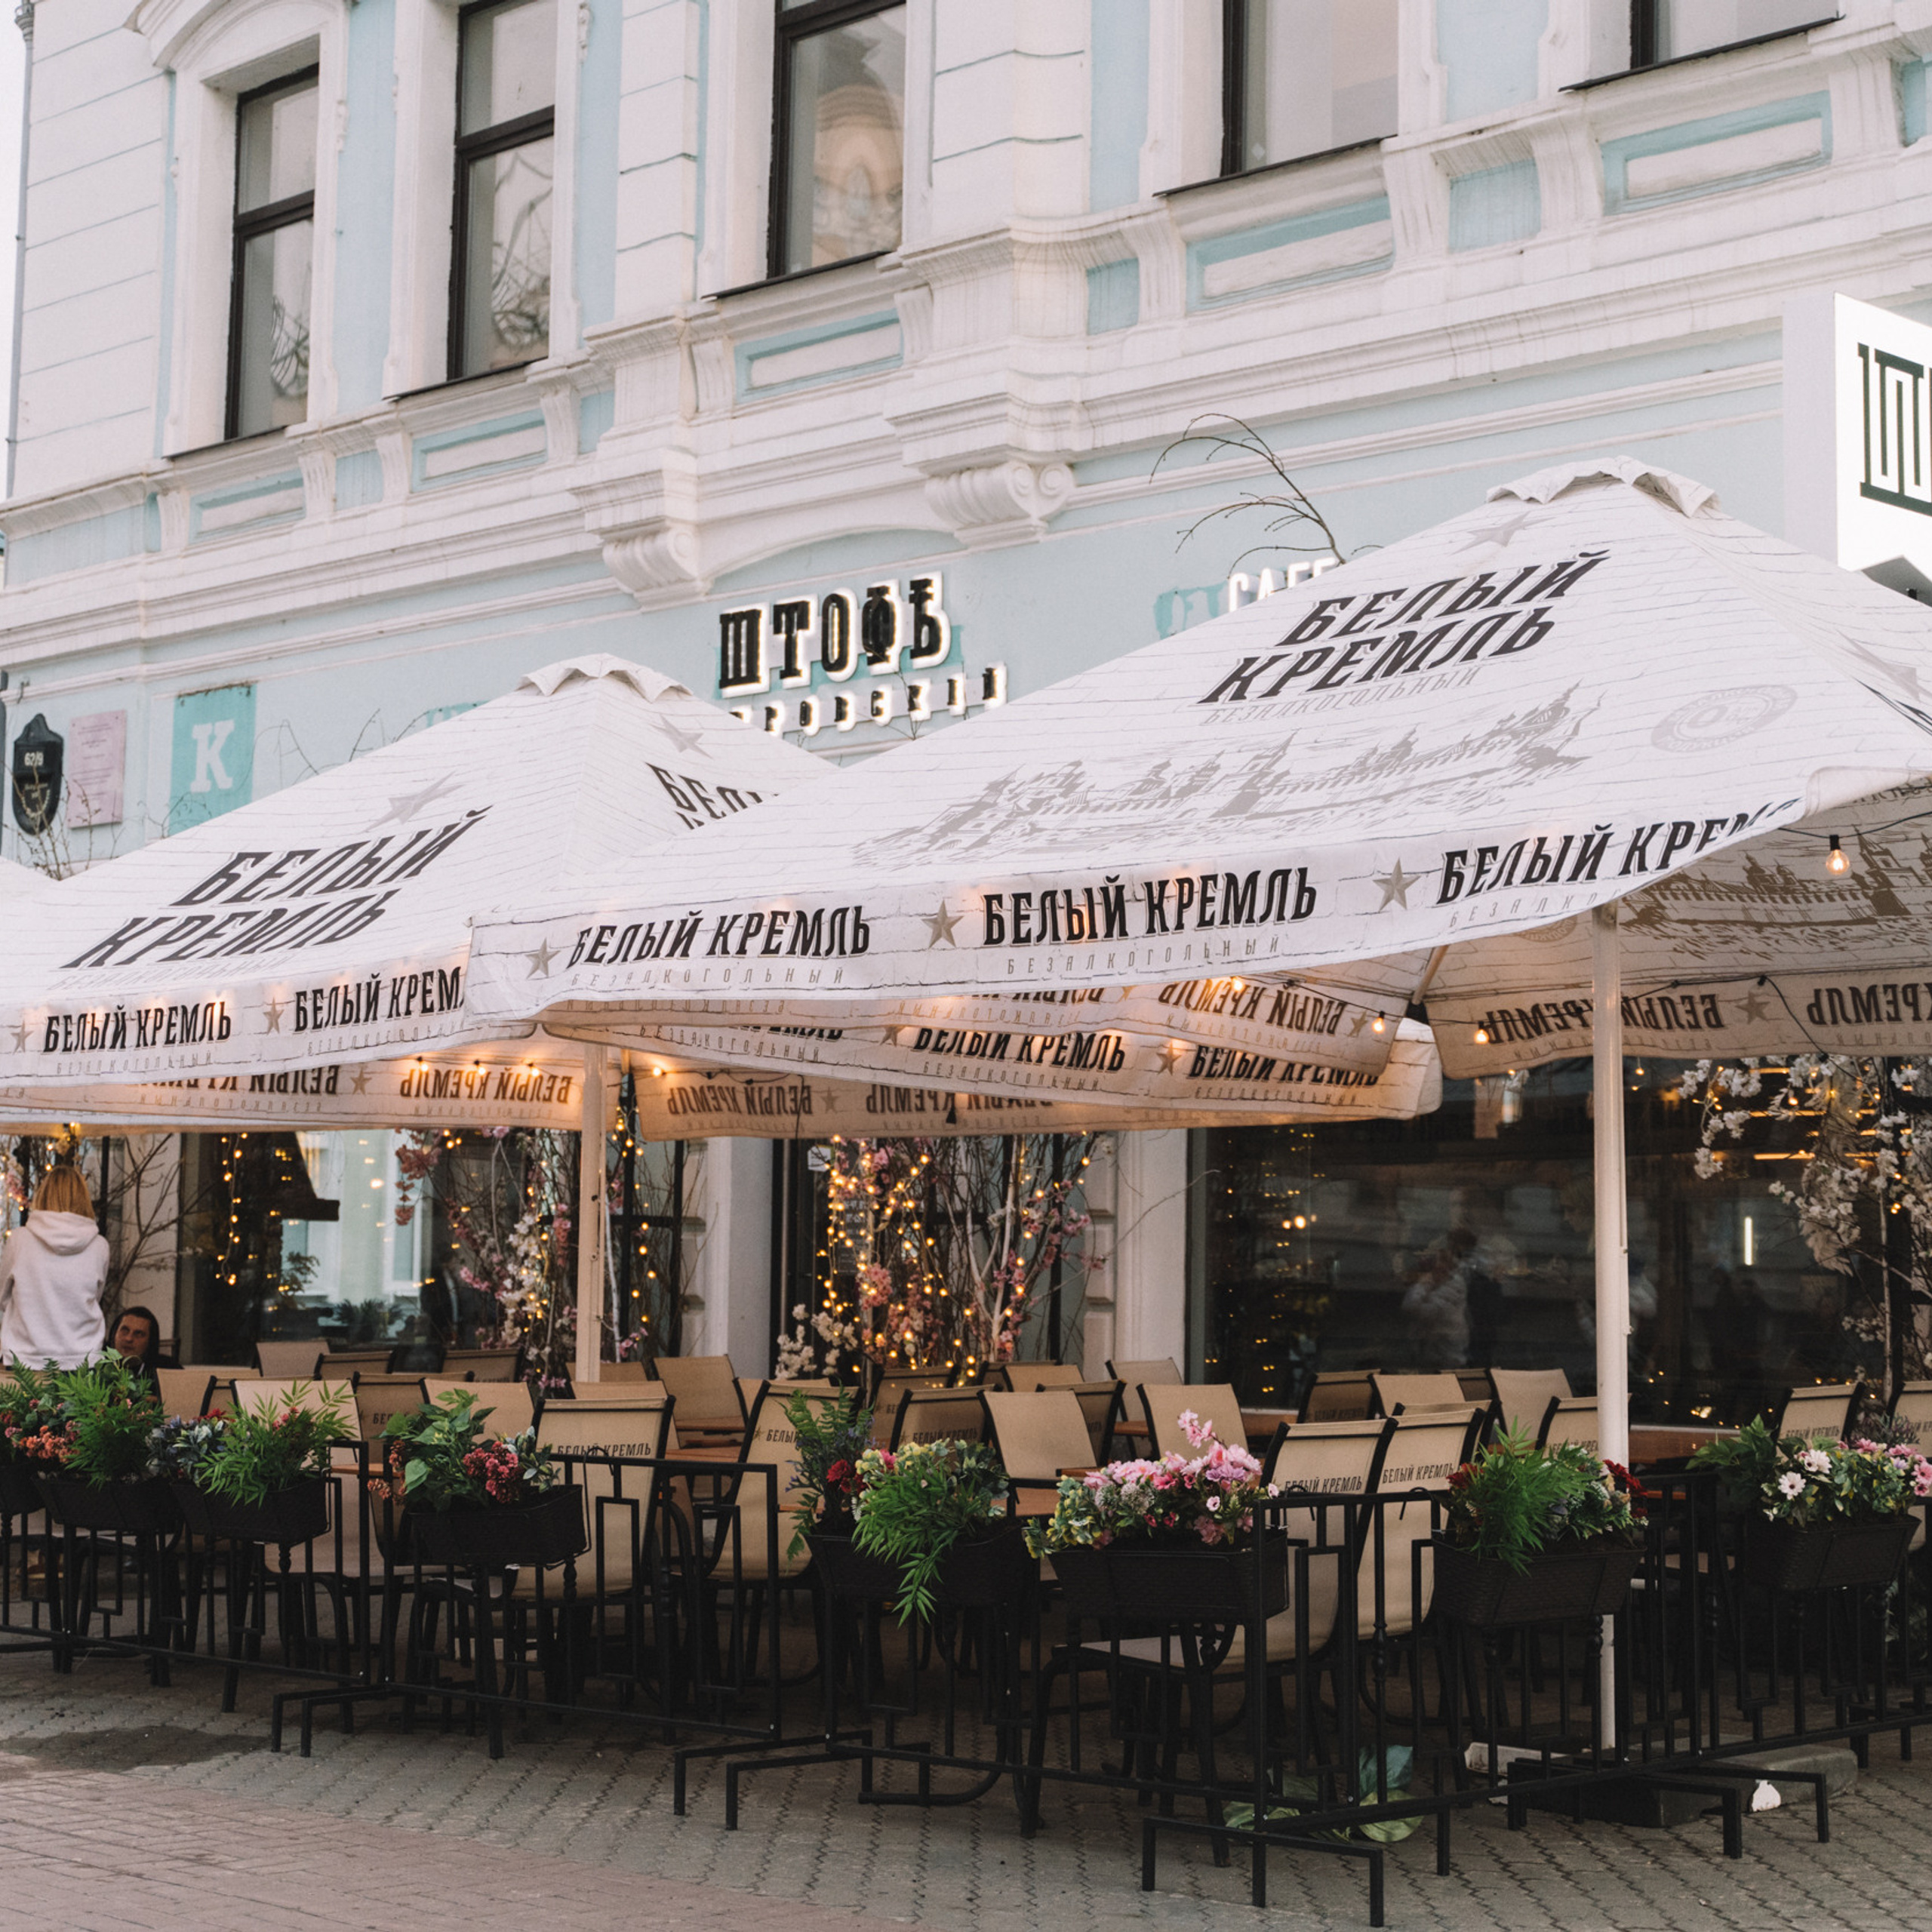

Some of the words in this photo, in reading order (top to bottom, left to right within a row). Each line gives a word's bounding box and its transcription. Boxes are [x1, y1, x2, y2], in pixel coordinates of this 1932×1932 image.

[1274, 549, 1611, 647] БЕЛЫЙ
[1195, 606, 1555, 689] КРЕМЛЬ
[645, 762, 780, 819] БЕЛ
[168, 805, 493, 906] БЕЛЫЙ
[1437, 824, 1613, 904] БЕЛЫЙ
[60, 889, 401, 969] КРЕМЛЬ
[565, 910, 703, 969] БЕЛЫЙ
[706, 906, 870, 956] КРЕМЛЬ
[983, 875, 1130, 946] БЕЛЫЙ
[1145, 867, 1317, 934] КРЕМЛЬ
[44, 1004, 127, 1053] БЕЛЫЙ
[136, 1001, 231, 1048] КРЕМЛЬ
[295, 973, 379, 1032] БЕЛЫЙ
[387, 966, 464, 1019] КРЕМ
[1383, 1464, 1414, 1484] БЕЛЫЙ
